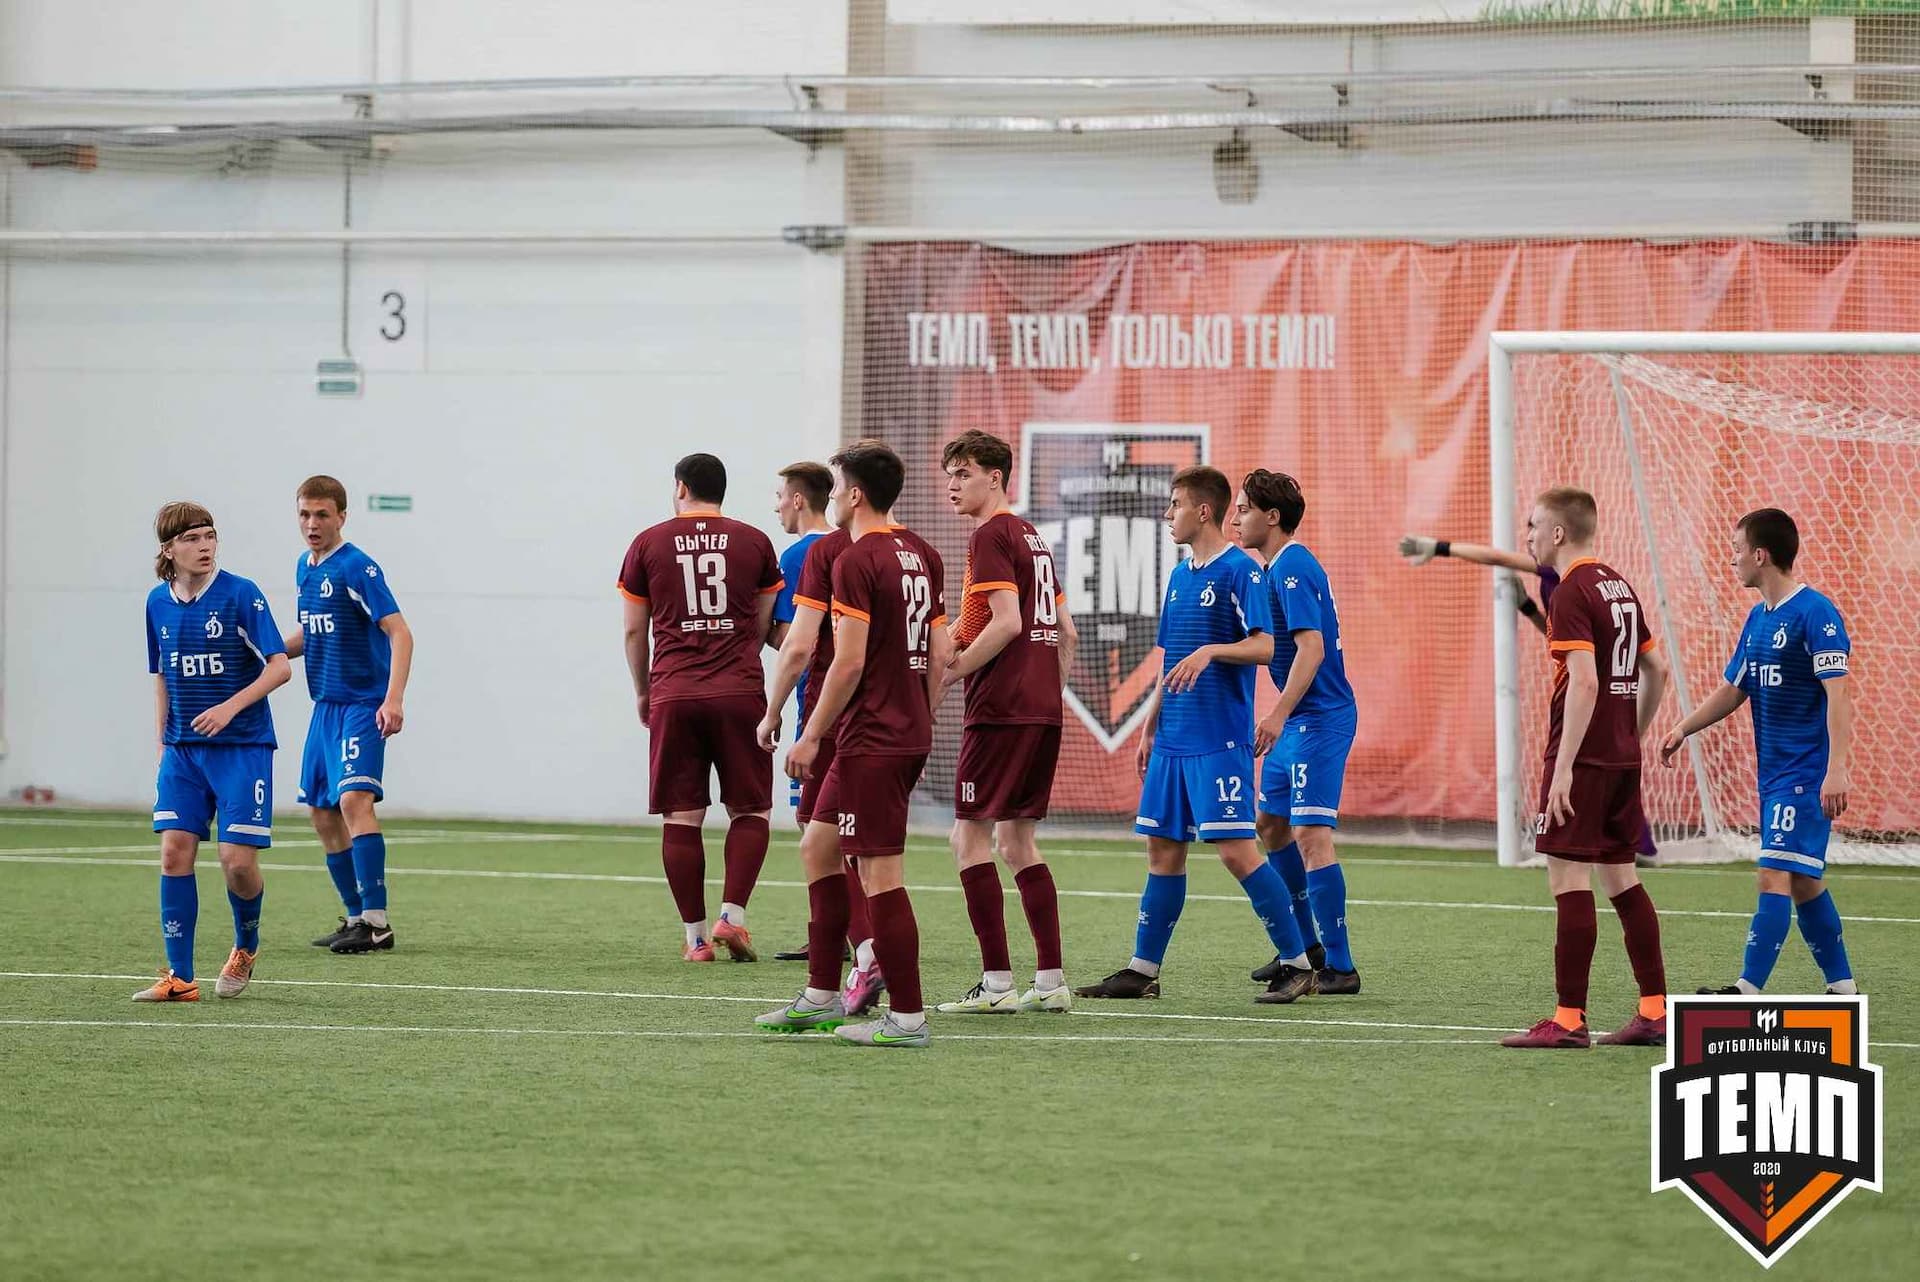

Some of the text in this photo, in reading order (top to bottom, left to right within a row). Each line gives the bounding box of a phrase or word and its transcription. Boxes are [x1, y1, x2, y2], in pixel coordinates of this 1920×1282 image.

[380, 291, 406, 341] 3
[907, 312, 1337, 374] ТЕМП, ТЕМП, ТОЛЬКО ТЕМП!
[674, 533, 729, 552] СЫЧЕВ
[676, 552, 727, 616] 13
[1032, 555, 1057, 626] 18
[309, 613, 335, 634] ВТБ
[681, 618, 735, 633] SEUS
[901, 574, 931, 652] 22
[1610, 602, 1638, 677] 27
[181, 653, 225, 677] ВТБ
[340, 736, 360, 762] 15
[1215, 776, 1242, 802] 12
[1291, 763, 1308, 789] 13
[254, 779, 266, 805] 6
[961, 781, 976, 803] 18
[838, 812, 856, 836] 22
[1770, 803, 1797, 832] 18
